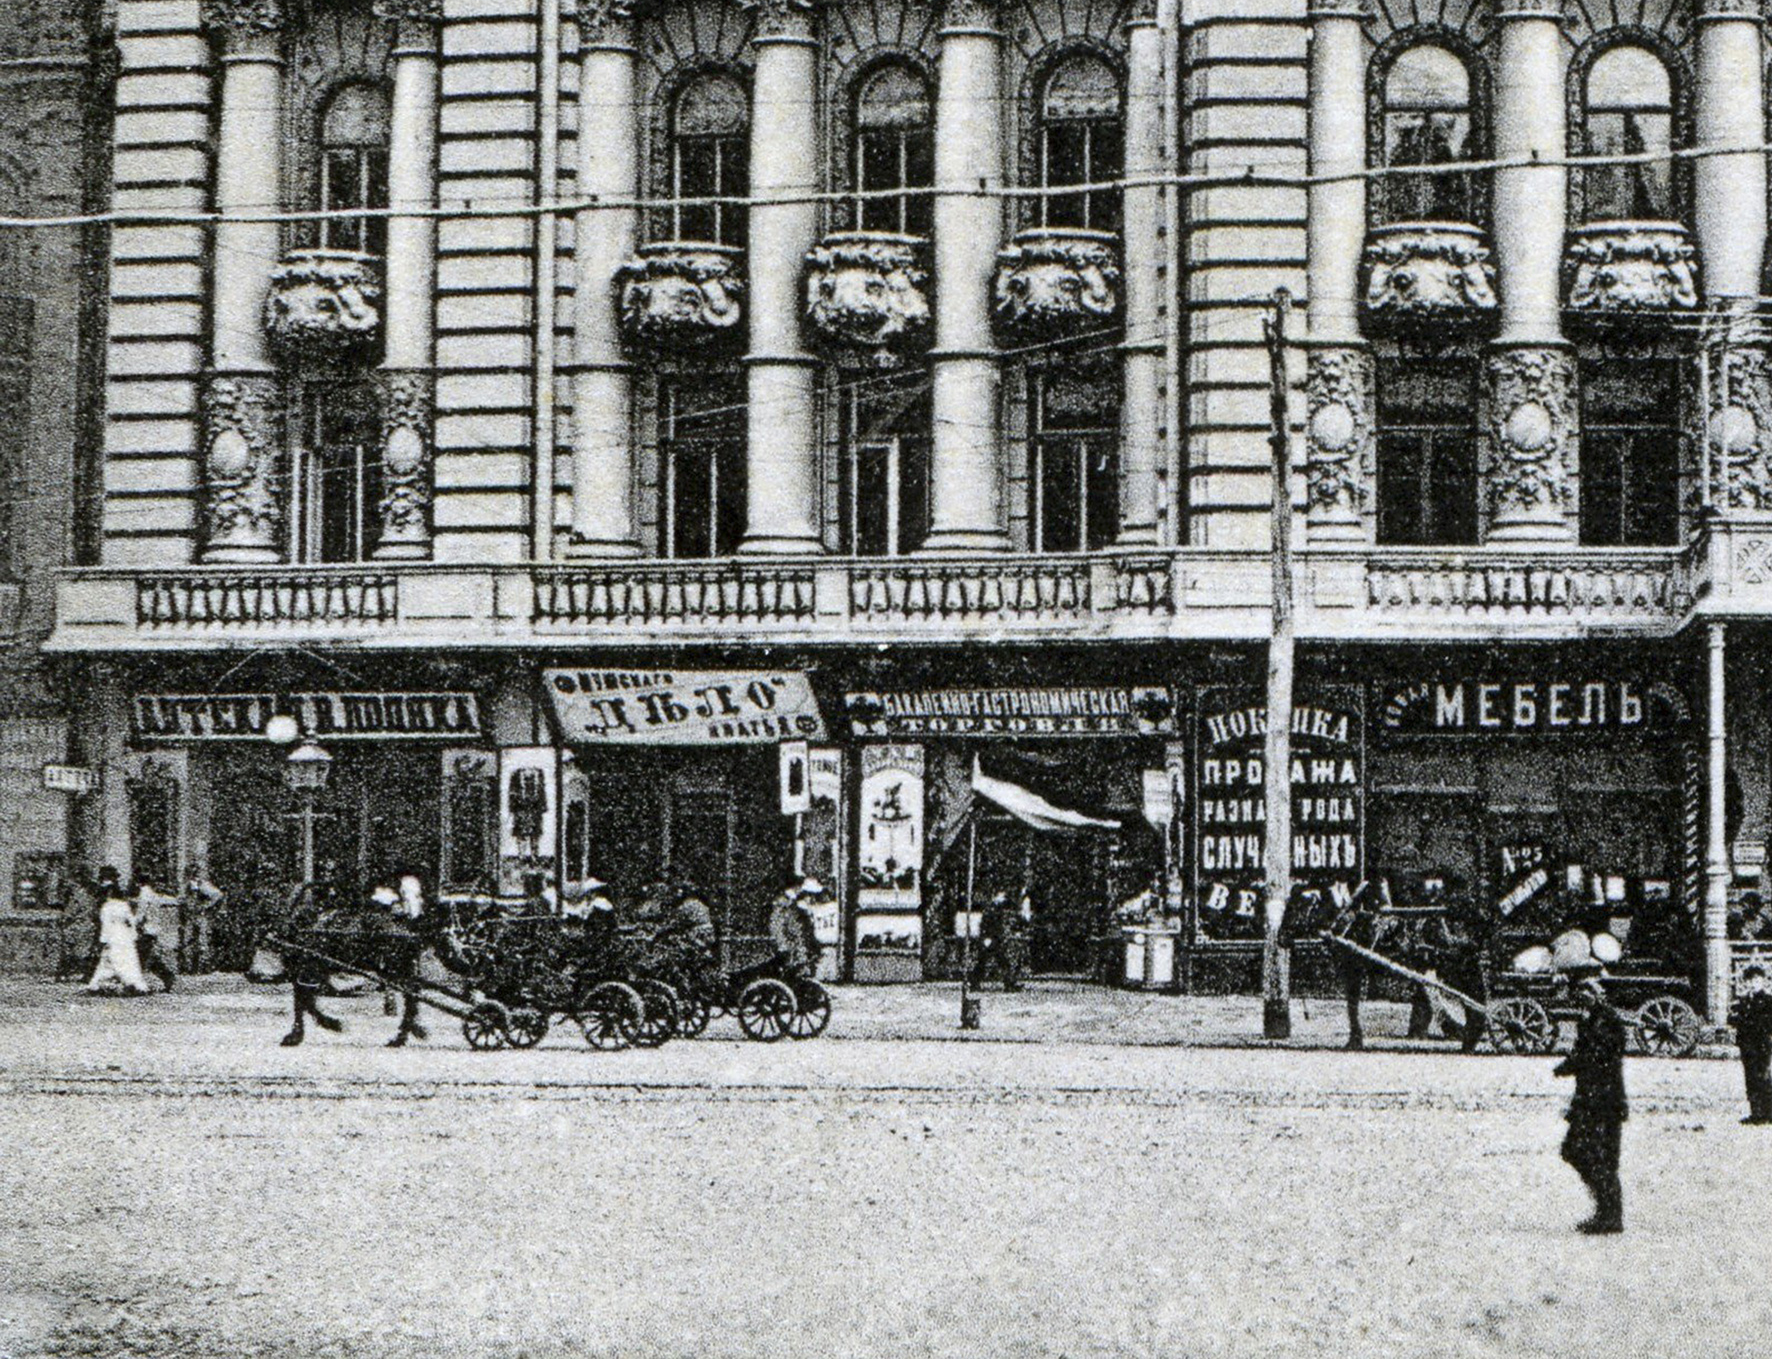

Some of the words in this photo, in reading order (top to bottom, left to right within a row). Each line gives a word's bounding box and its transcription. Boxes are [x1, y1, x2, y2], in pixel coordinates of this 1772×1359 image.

[1435, 682, 1642, 727] МЕБЕЛЬ
[1207, 707, 1349, 744] ПОКПКА
[1203, 759, 1357, 785] ПРОАЖА
[1203, 799, 1267, 823] РАЗНА
[1301, 797, 1356, 822] РОДА
[1203, 834, 1357, 870] СЛУЧНЫХЪ
